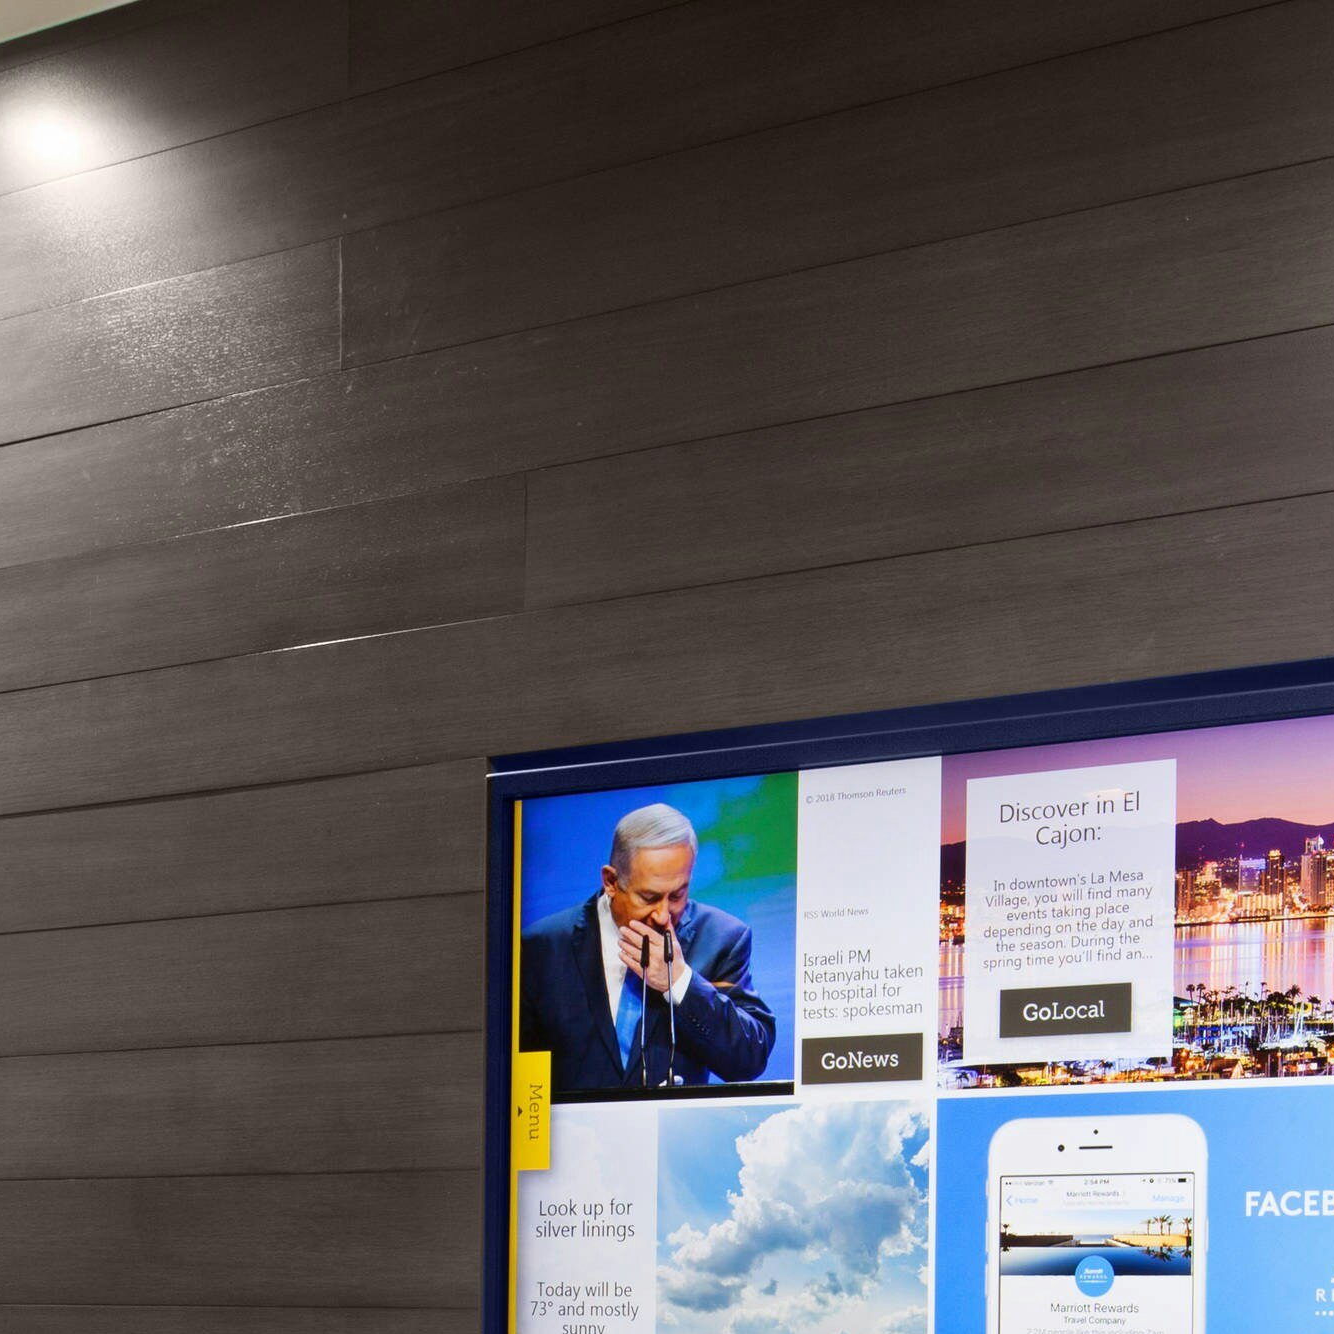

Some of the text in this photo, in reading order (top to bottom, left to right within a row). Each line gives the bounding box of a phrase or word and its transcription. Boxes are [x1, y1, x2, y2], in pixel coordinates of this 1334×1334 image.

[816, 793, 835, 803] 2018
[838, 790, 874, 801] Thomson
[876, 786, 906, 797] Reuters
[1000, 791, 1140, 823] Discover in El
[1036, 824, 1101, 849] Cajon:
[994, 869, 1144, 892] In downtown's La Mesa
[985, 886, 1153, 910] Village, you will find many
[821, 908, 845, 918] World
[847, 907, 869, 916] News
[1006, 902, 1130, 921] events taking place
[983, 915, 1153, 940] depending on the day and
[996, 932, 1141, 954] the season. During the
[803, 949, 871, 967] Israeli PM
[983, 955, 1022, 971] spring
[1026, 953, 1054, 967] time
[1058, 949, 1093, 968] you'll
[1097, 949, 1122, 961] find
[803, 964, 924, 985] Netanyahu taken
[803, 983, 902, 1003] to hospital for
[803, 1002, 923, 1020] tests: spokesman
[1023, 1000, 1105, 1022] GoLocal
[821, 1051, 899, 1070] GoNews
[529, 1083, 543, 1141] Menu
[1066, 1190, 1091, 1198] Marriott
[539, 1198, 633, 1220] Look up for
[535, 1220, 635, 1242] silver linings
[537, 1281, 632, 1301] Today will be
[530, 1301, 639, 1321] 73° and mostly
[1050, 1303, 1139, 1314] Marriott Rewards
[1064, 1316, 1126, 1325] Travel Company
